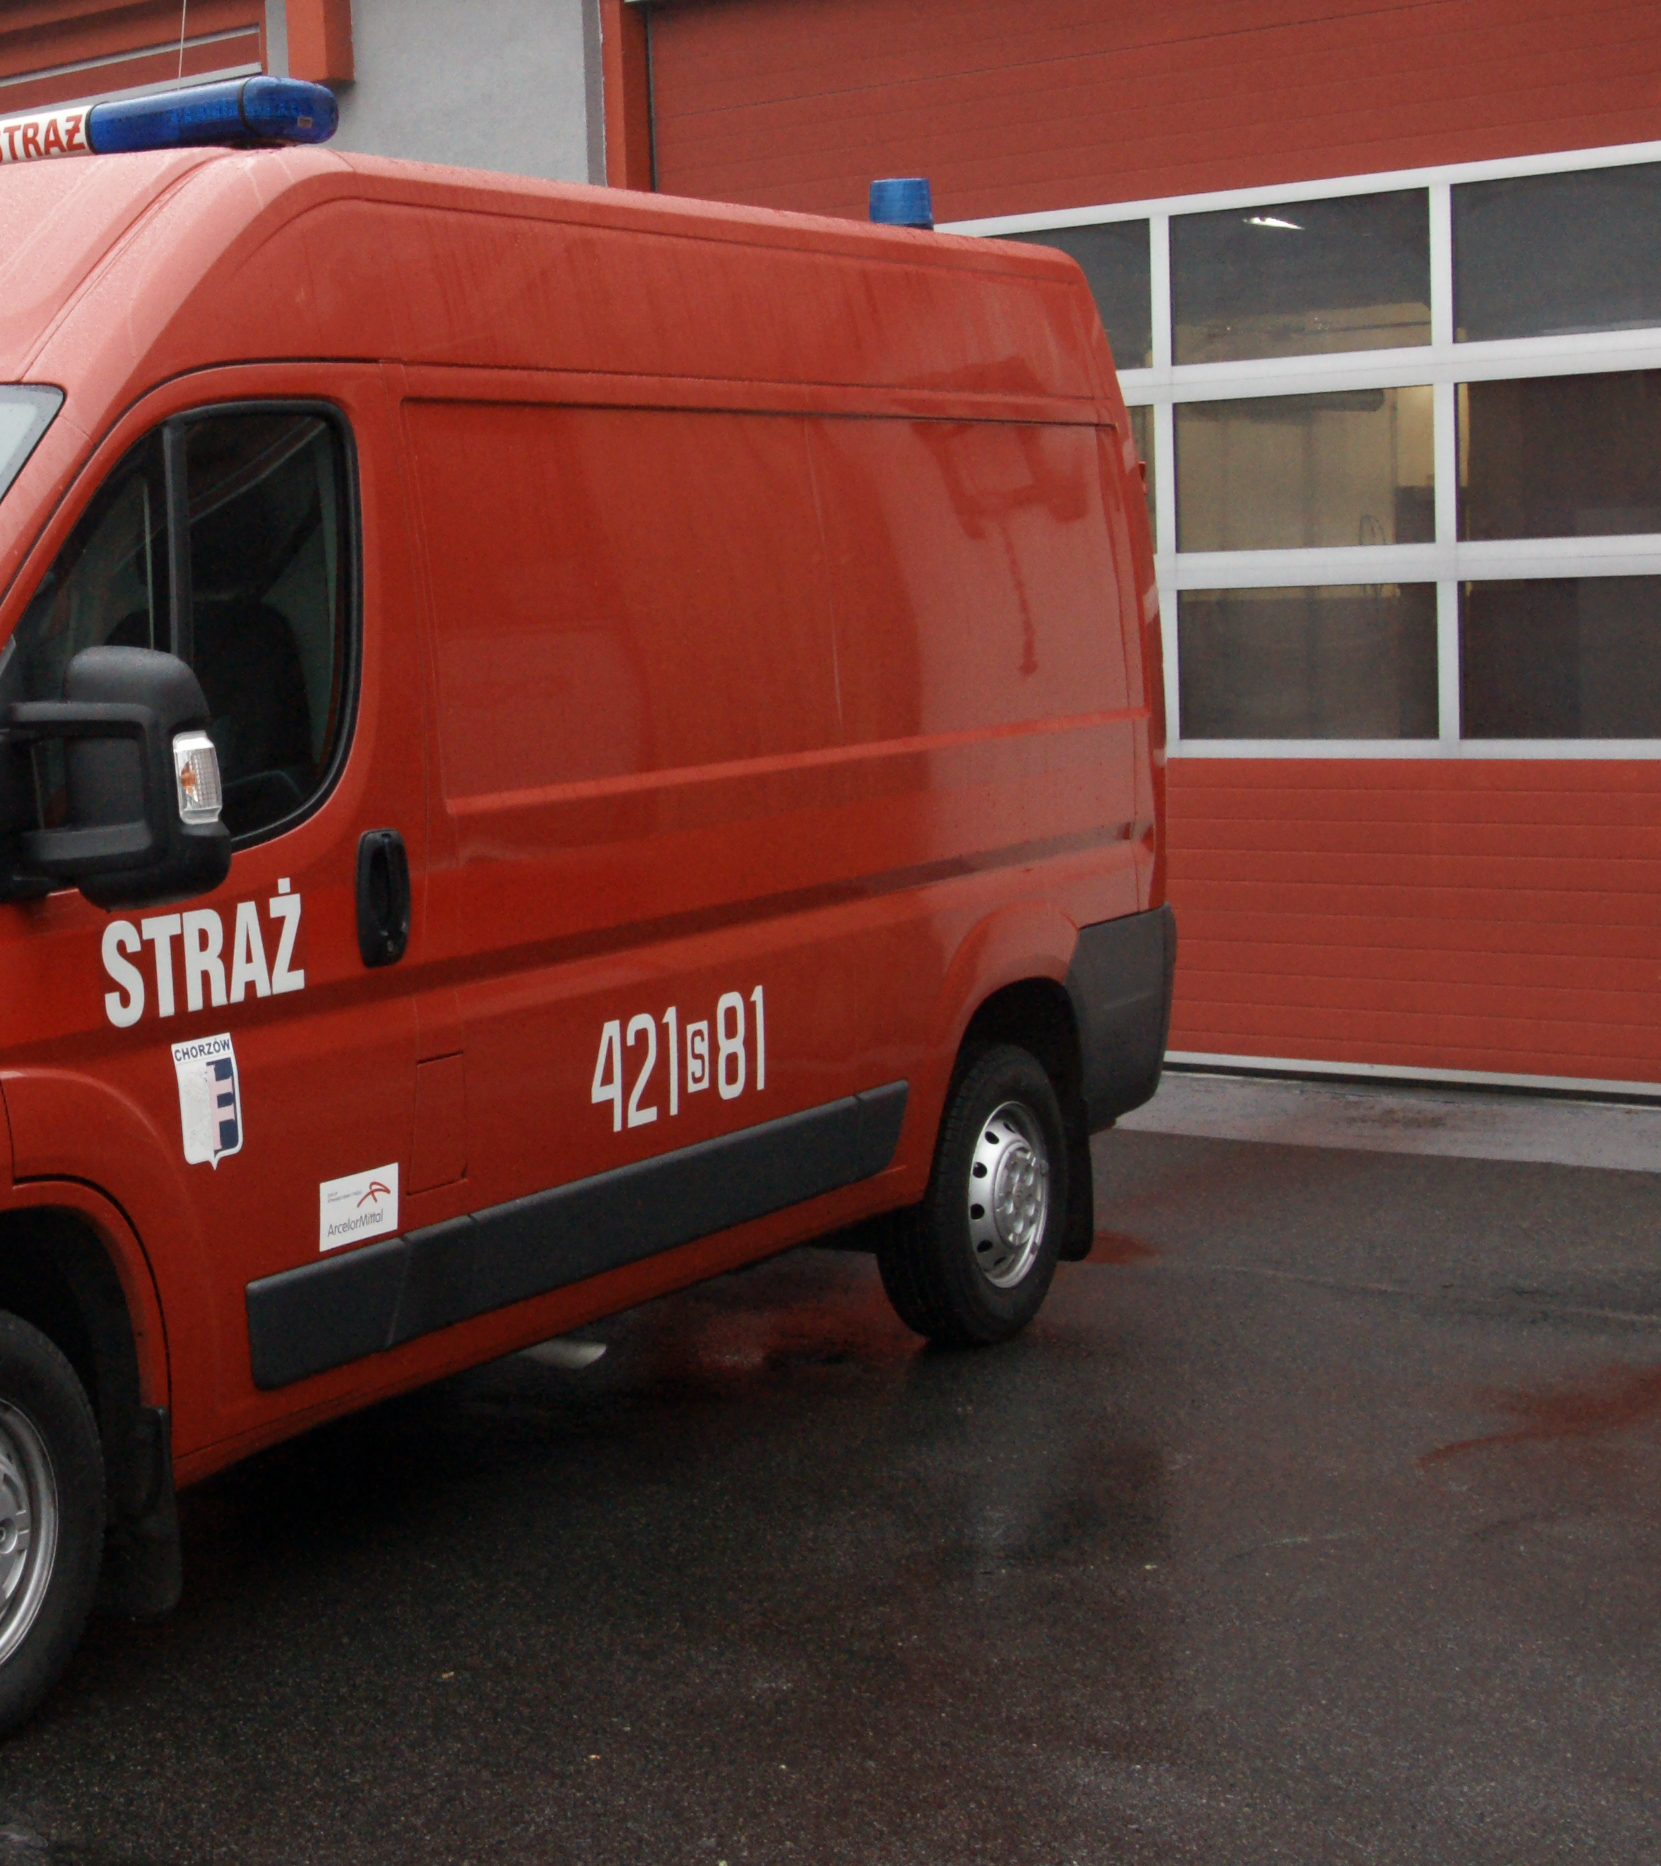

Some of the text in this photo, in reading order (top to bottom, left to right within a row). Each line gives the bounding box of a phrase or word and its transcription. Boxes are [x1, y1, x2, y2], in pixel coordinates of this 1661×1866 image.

[100, 877, 306, 1028] STRAŻ
[174, 1038, 231, 1062] CHORZÓW
[327, 1208, 384, 1238] ArcelorMittal
